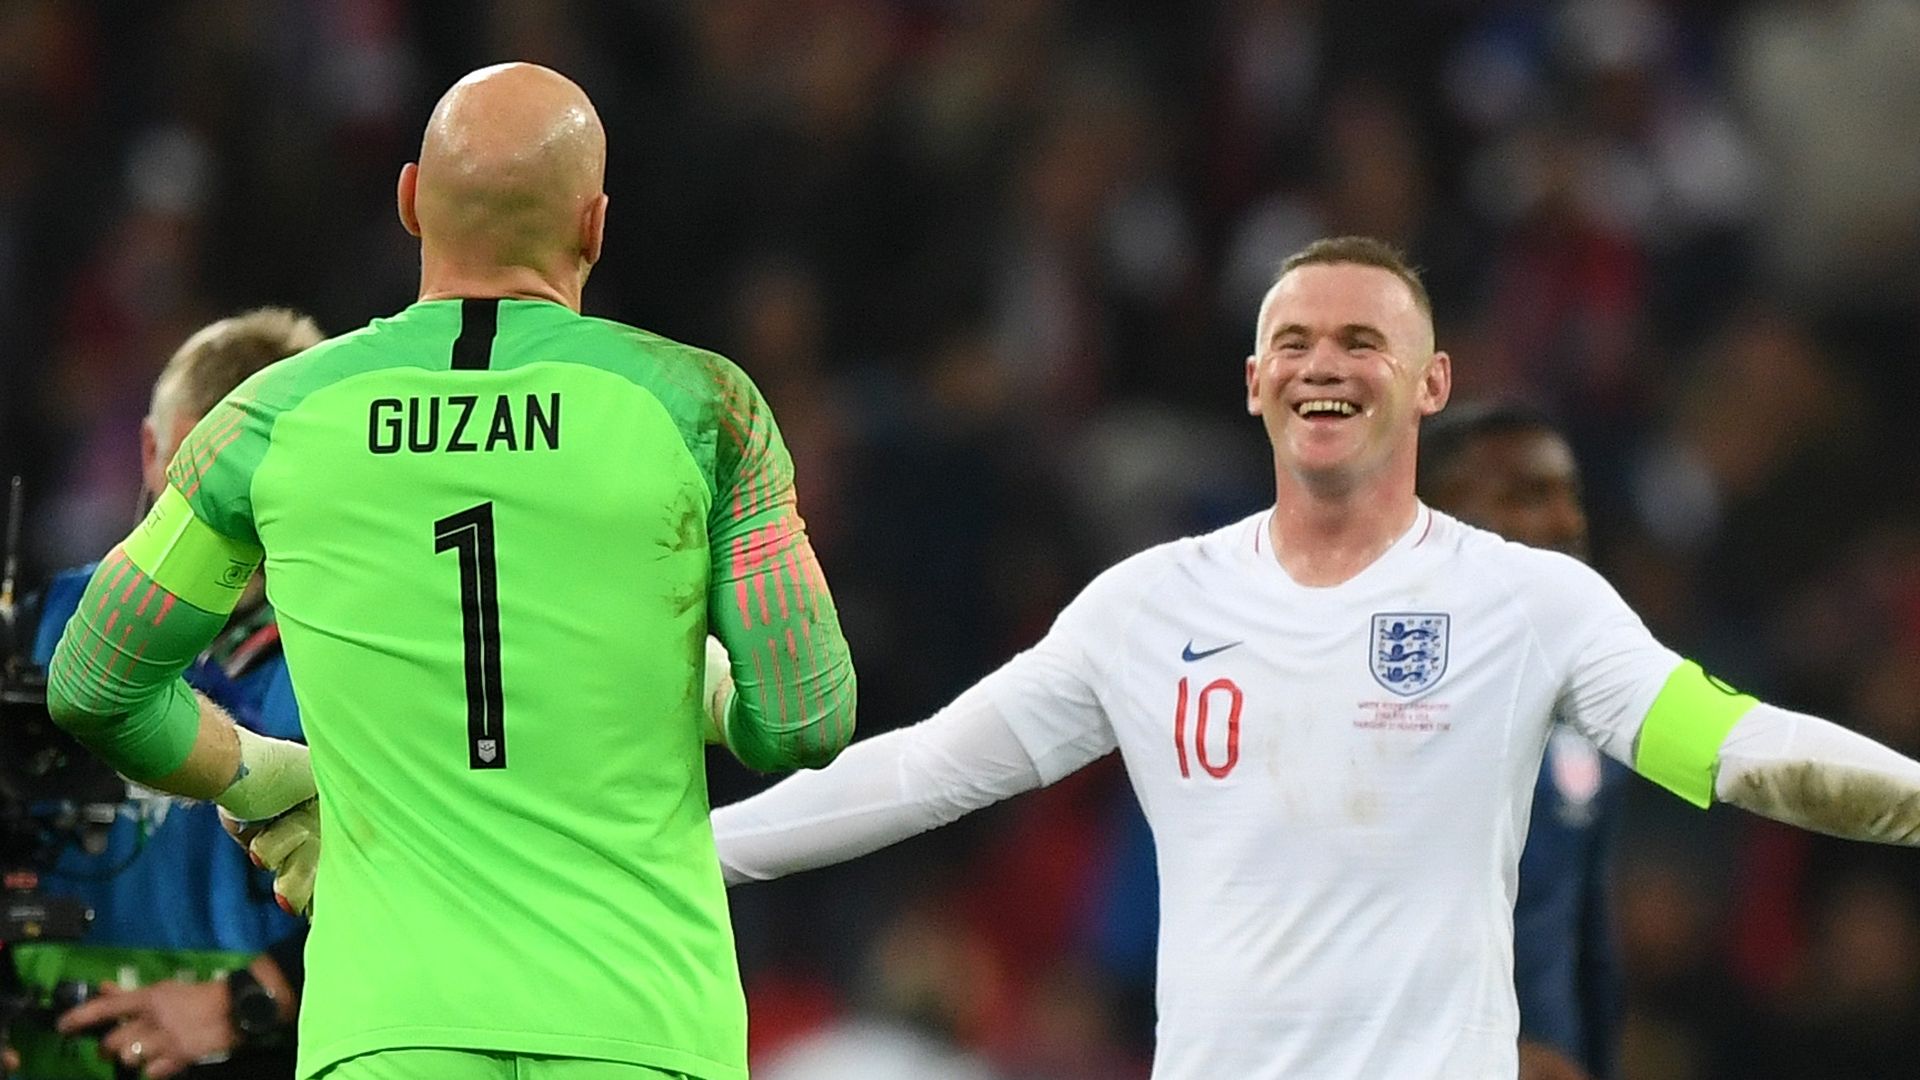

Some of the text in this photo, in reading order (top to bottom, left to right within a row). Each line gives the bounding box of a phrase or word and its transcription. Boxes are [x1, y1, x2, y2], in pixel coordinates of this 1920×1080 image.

[368, 393, 560, 454] GUZAN
[434, 501, 507, 770] 1
[1175, 677, 1243, 779] 10
